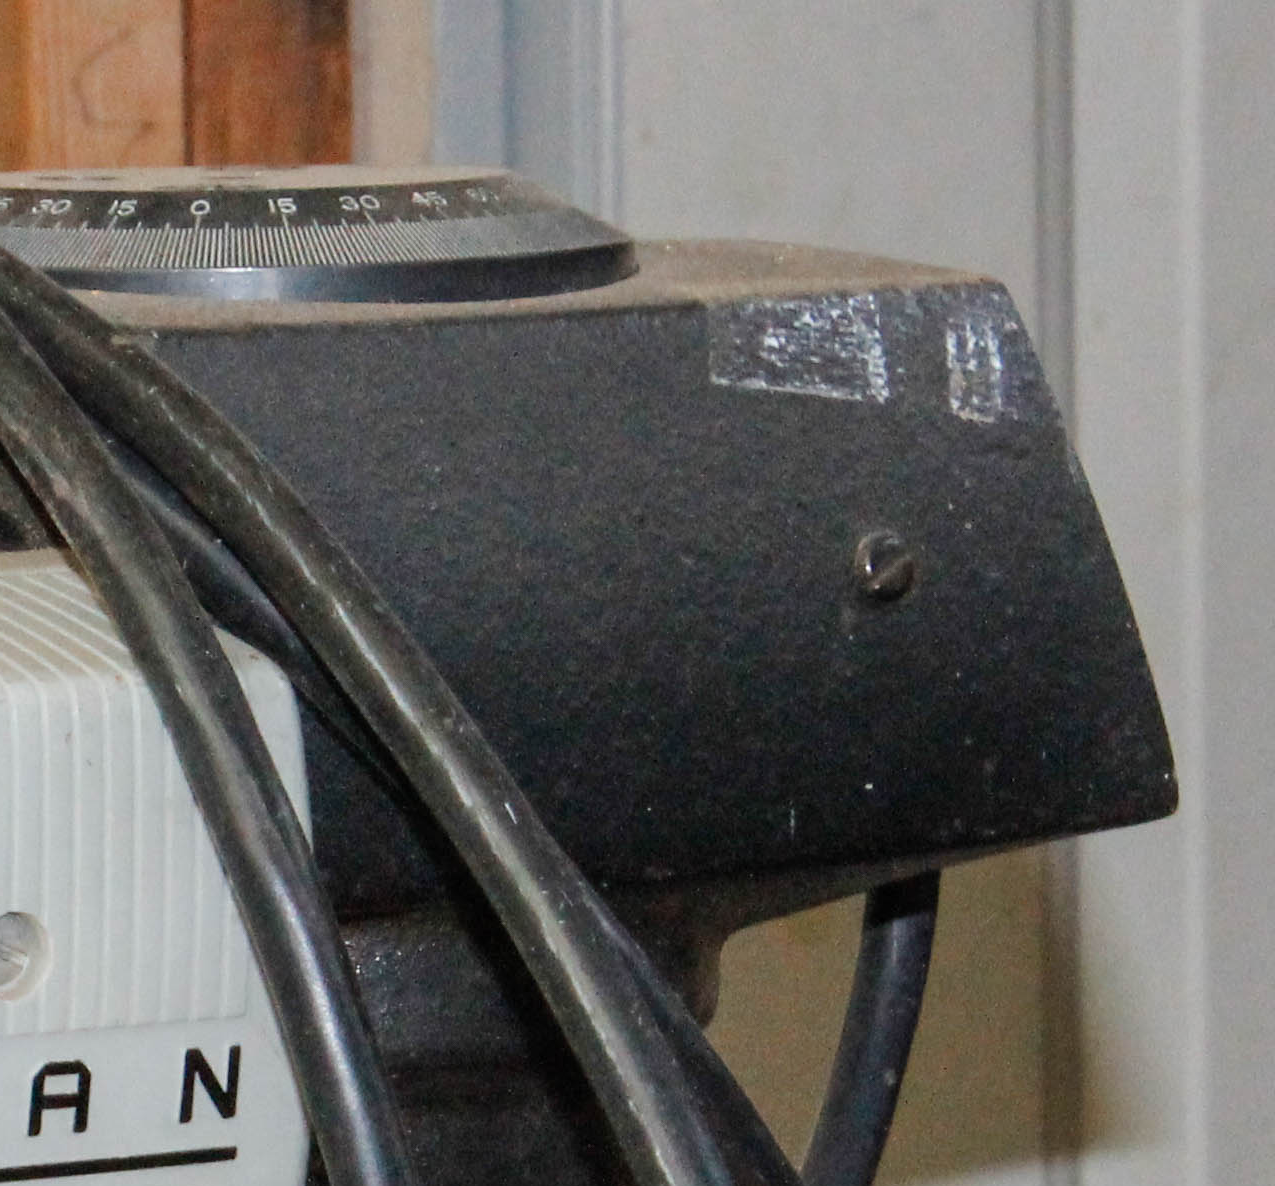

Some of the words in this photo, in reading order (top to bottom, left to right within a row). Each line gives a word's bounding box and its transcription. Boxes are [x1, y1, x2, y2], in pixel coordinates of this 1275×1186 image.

[31, 198, 73, 216] 30
[107, 198, 138, 217] 15
[190, 199, 211, 217] 0
[267, 196, 299, 216] 15
[338, 193, 382, 212] 30
